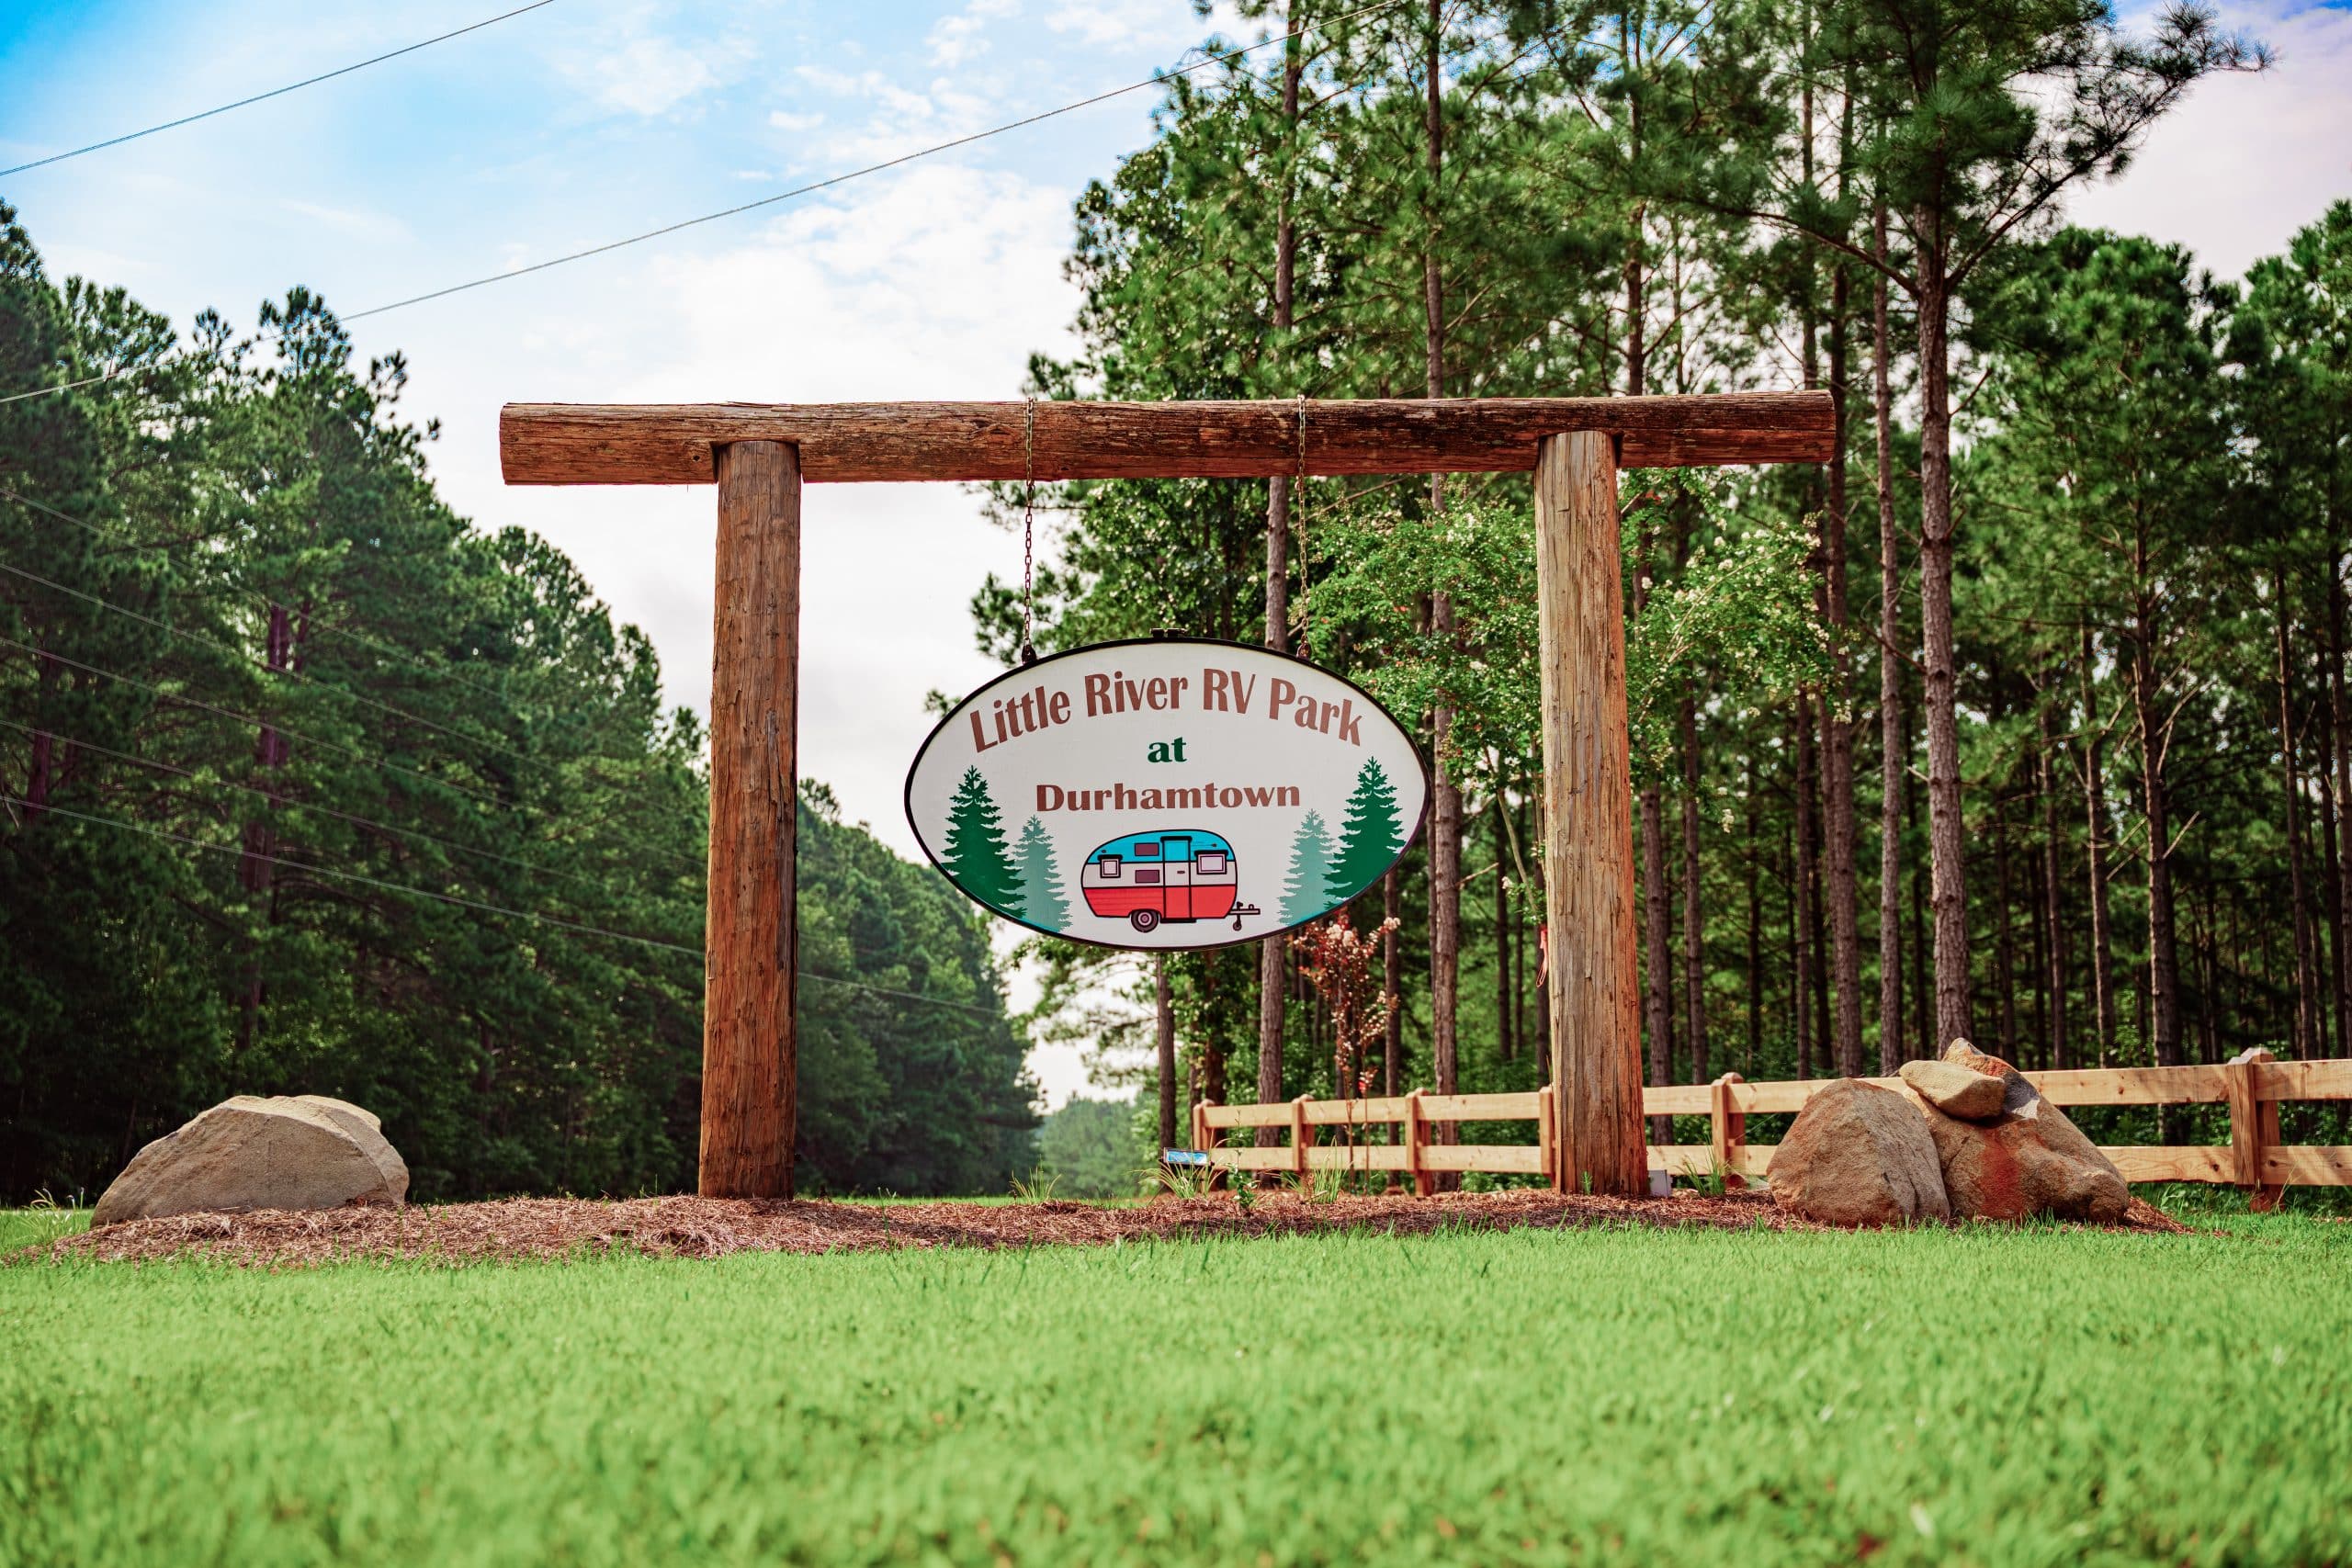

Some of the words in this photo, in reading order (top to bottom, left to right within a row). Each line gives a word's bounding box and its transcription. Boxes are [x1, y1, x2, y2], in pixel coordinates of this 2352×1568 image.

[970, 685, 1071, 753] Little
[1085, 671, 1189, 717] River
[1203, 668, 1256, 714] RV
[1269, 678, 1363, 747] Park
[1148, 736, 1187, 763] at
[1035, 783, 1301, 812] Durhamtown
